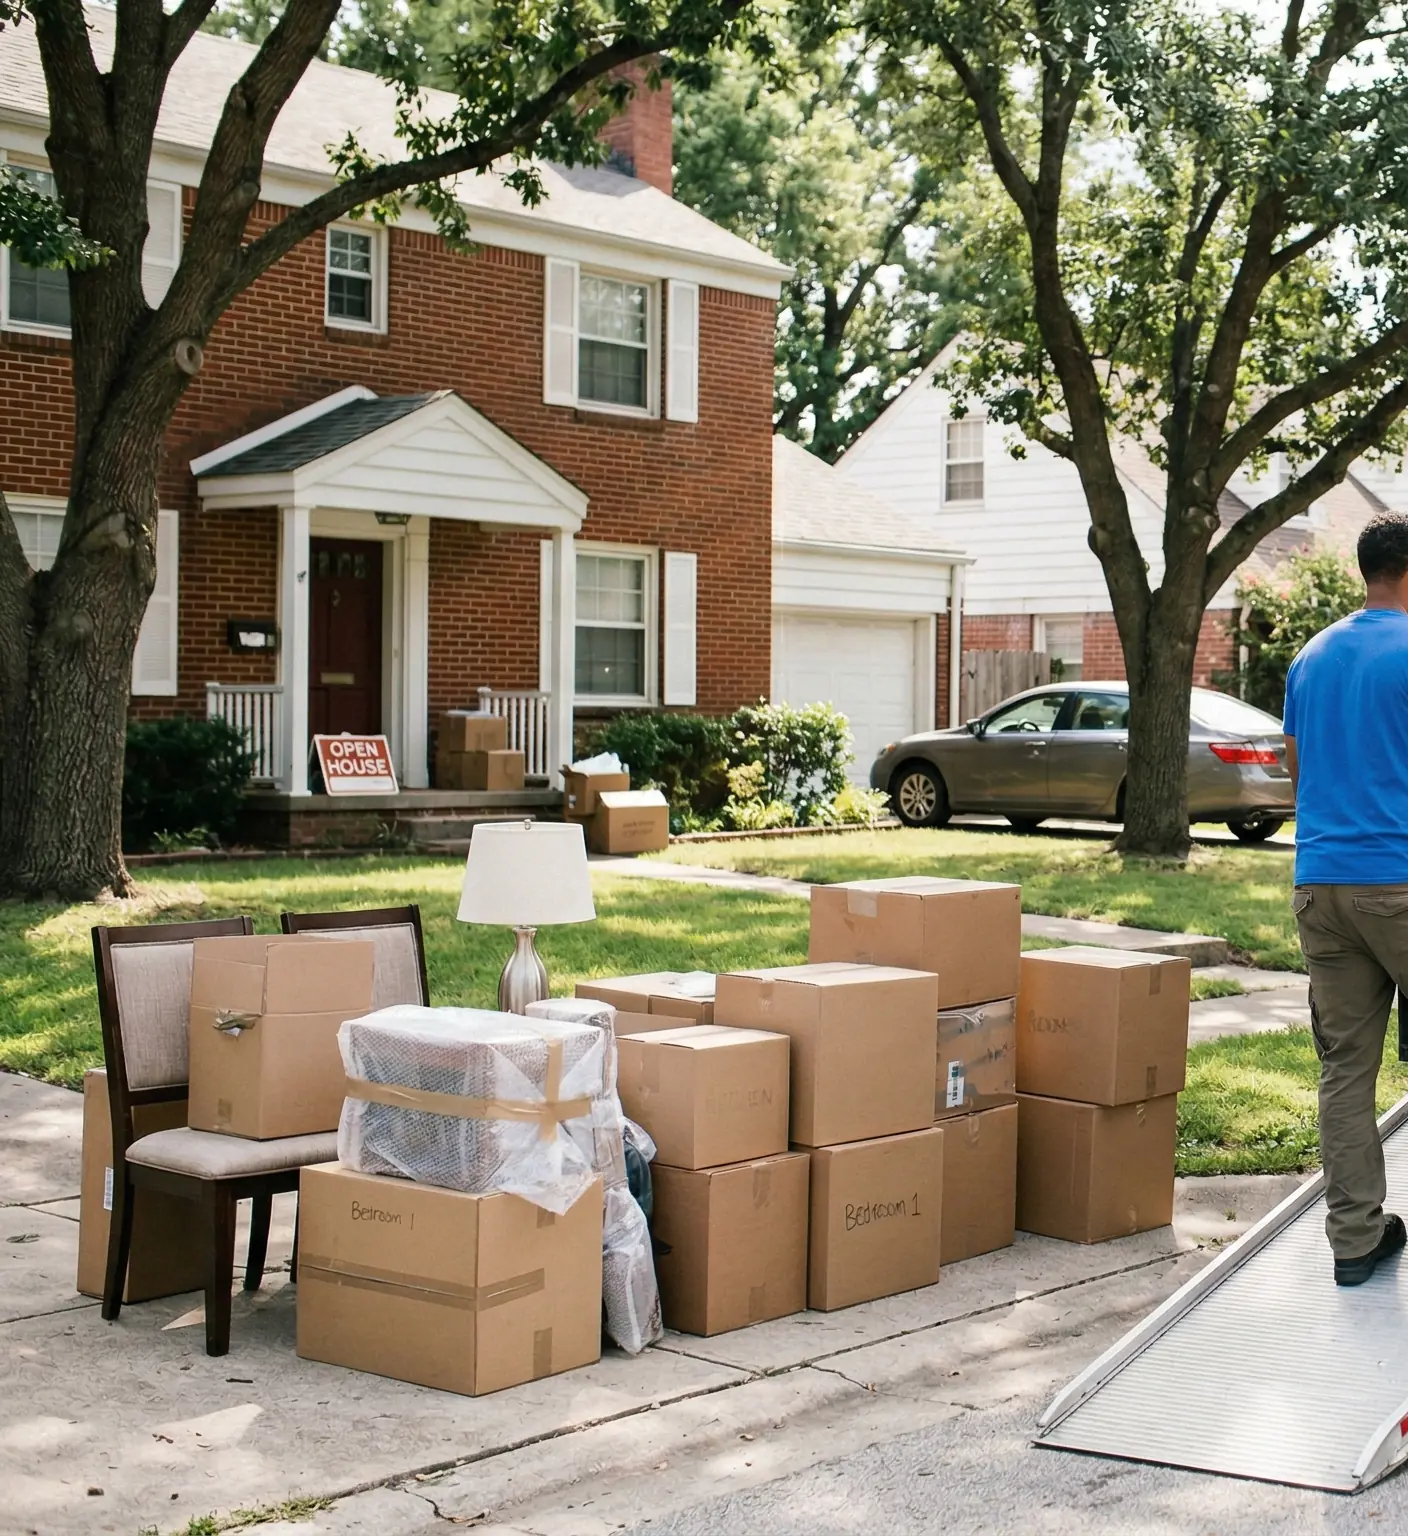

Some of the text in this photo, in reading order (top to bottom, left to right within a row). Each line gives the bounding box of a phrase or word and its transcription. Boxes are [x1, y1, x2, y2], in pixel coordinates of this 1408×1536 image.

[329, 741, 379, 757] OPEN
[326, 758, 389, 775] HOUSE
[911, 1192, 921, 1216] 1
